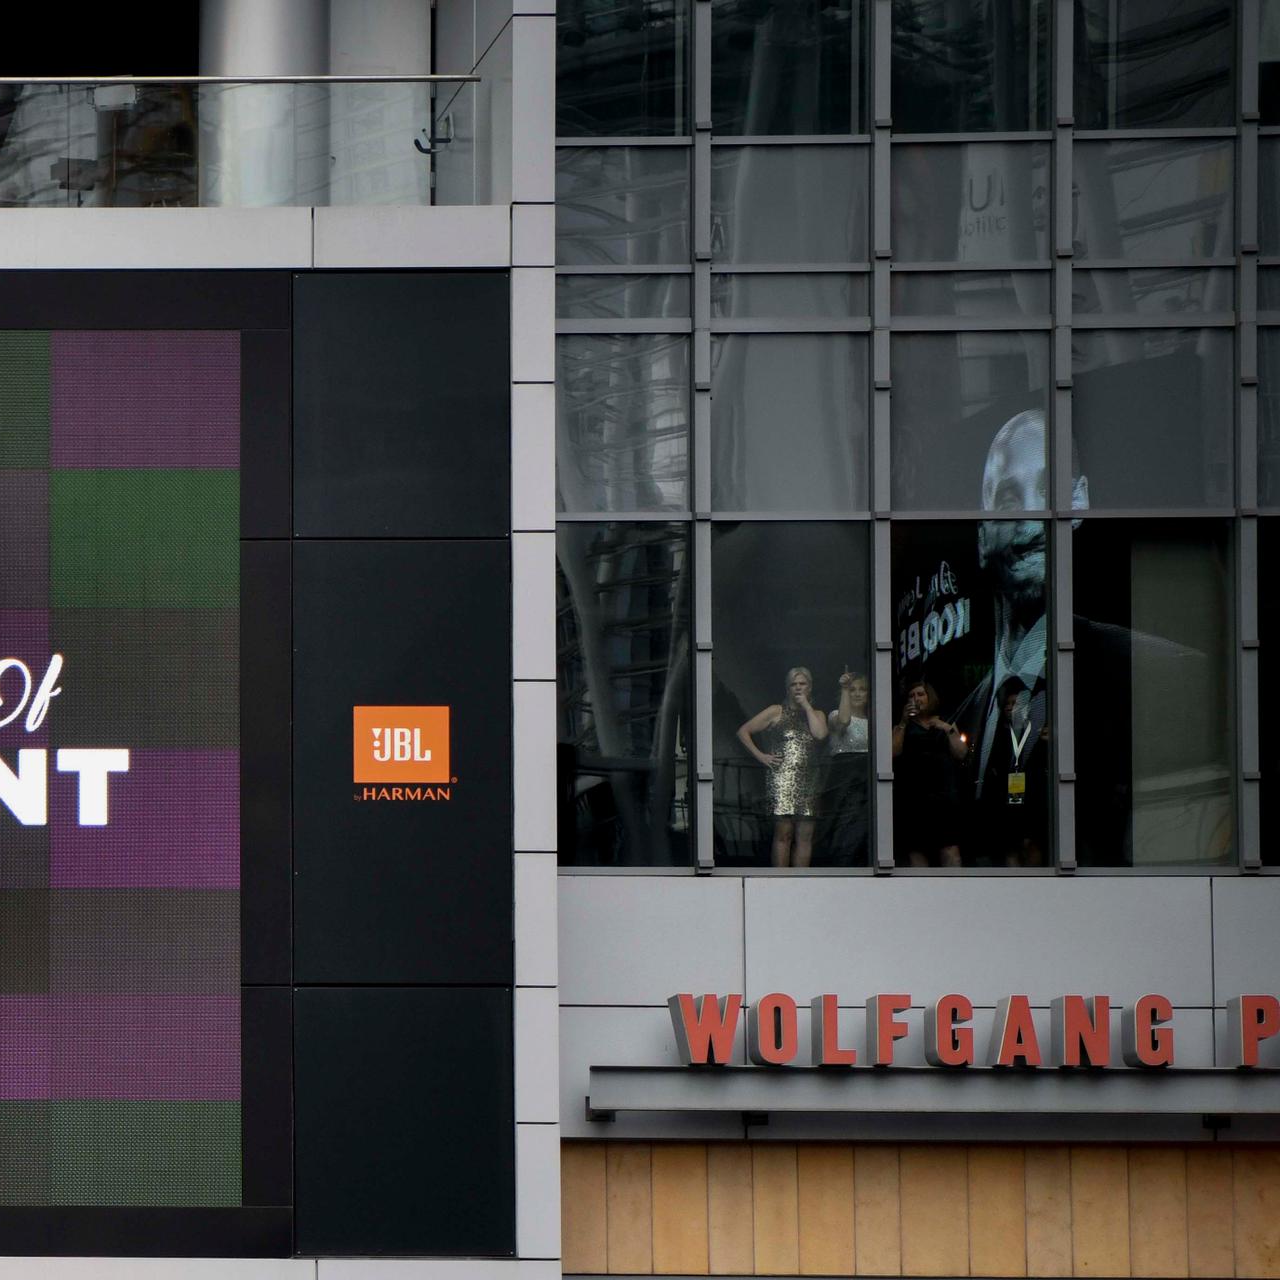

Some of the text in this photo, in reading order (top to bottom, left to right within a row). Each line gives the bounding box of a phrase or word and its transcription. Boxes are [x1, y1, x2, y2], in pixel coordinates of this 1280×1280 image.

[371, 727, 432, 761] JBL
[363, 787, 450, 801] HARMAN
[668, 992, 1175, 1067] WOLFGANG
